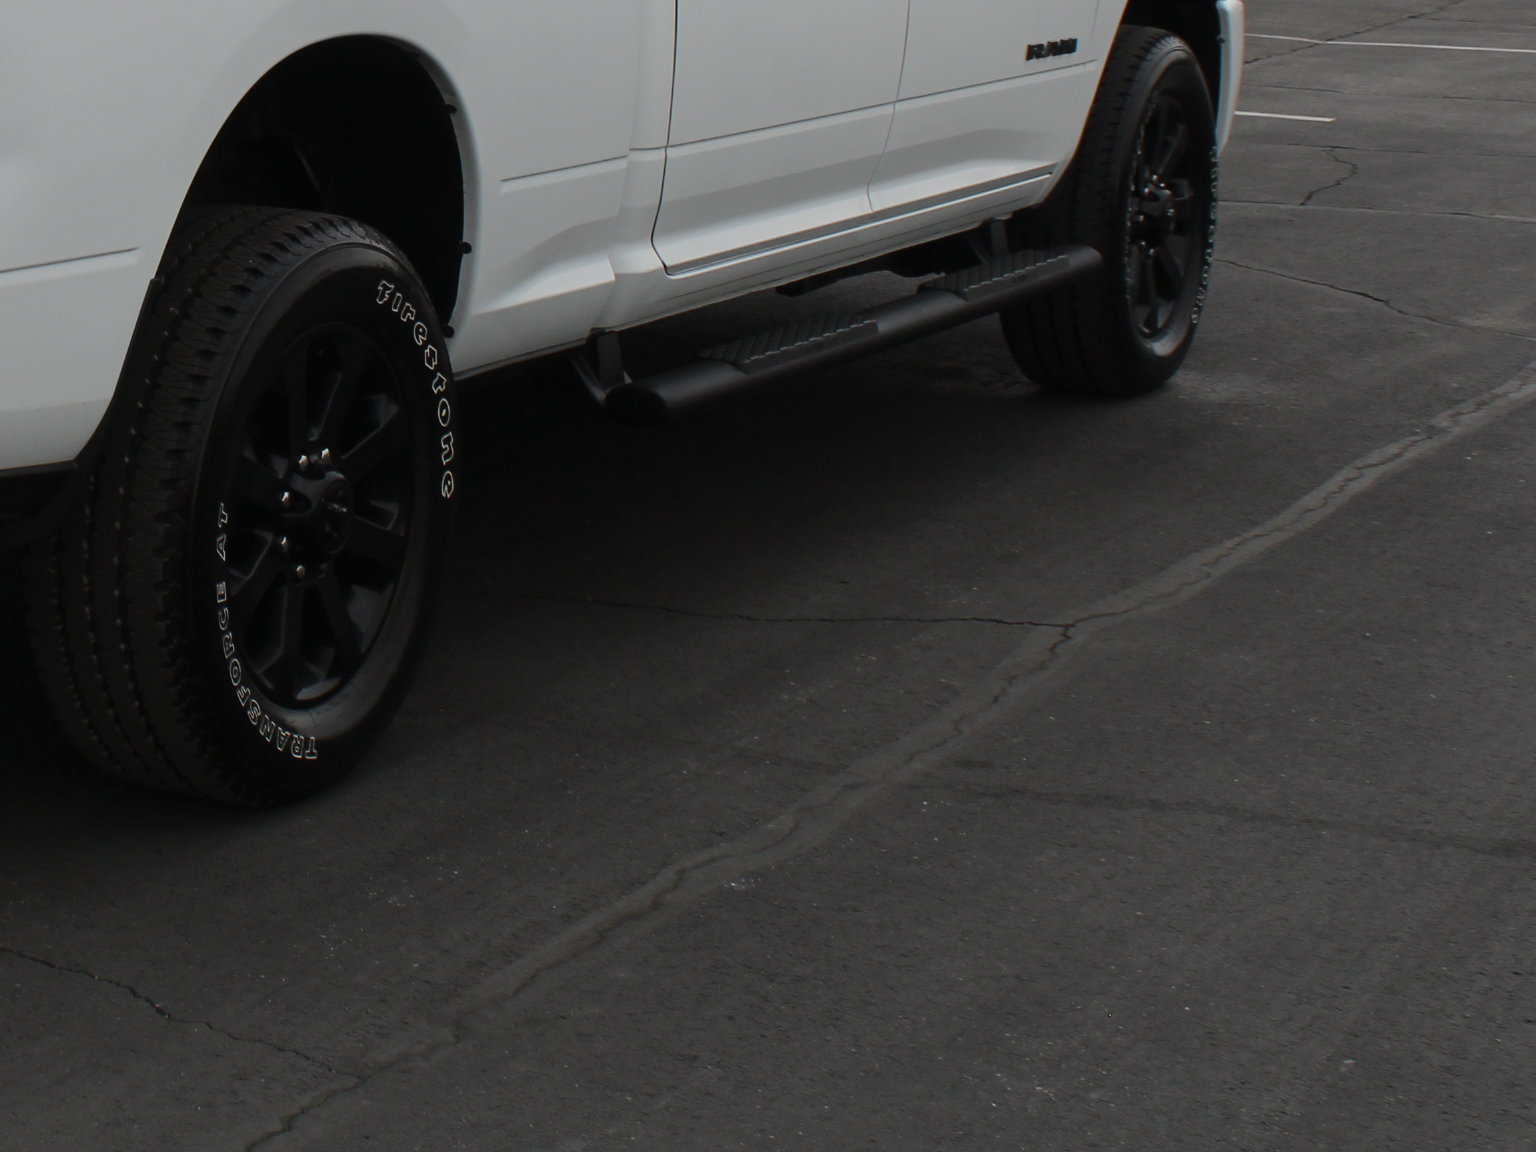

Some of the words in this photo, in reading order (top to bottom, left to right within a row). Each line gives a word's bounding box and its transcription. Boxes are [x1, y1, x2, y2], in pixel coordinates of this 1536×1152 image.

[375, 280, 457, 500] Firestone
[216, 502, 230, 561] AT
[215, 582, 319, 761] TRANSFORCE
